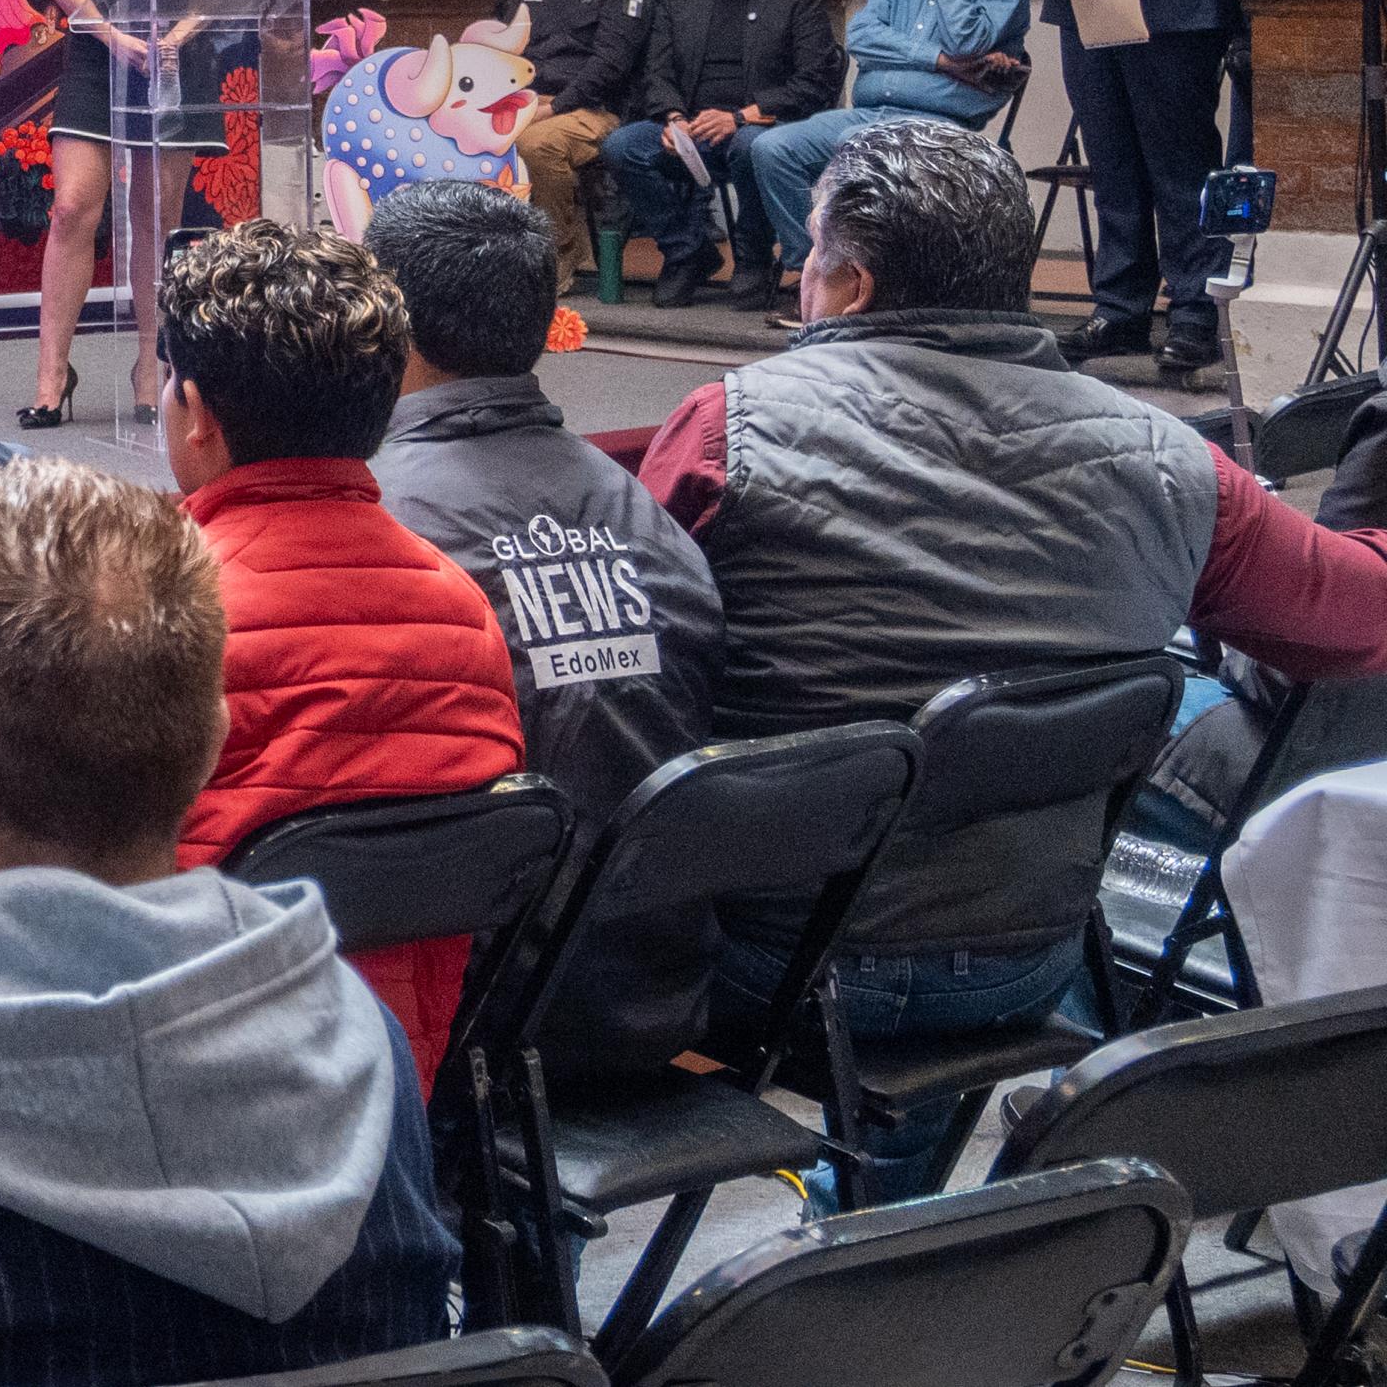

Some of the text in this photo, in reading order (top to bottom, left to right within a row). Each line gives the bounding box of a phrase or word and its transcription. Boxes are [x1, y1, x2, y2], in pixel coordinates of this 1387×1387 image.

[491, 514, 629, 561] GLOBAL
[501, 558, 651, 642] NEWS
[549, 646, 642, 678] EdoMex
